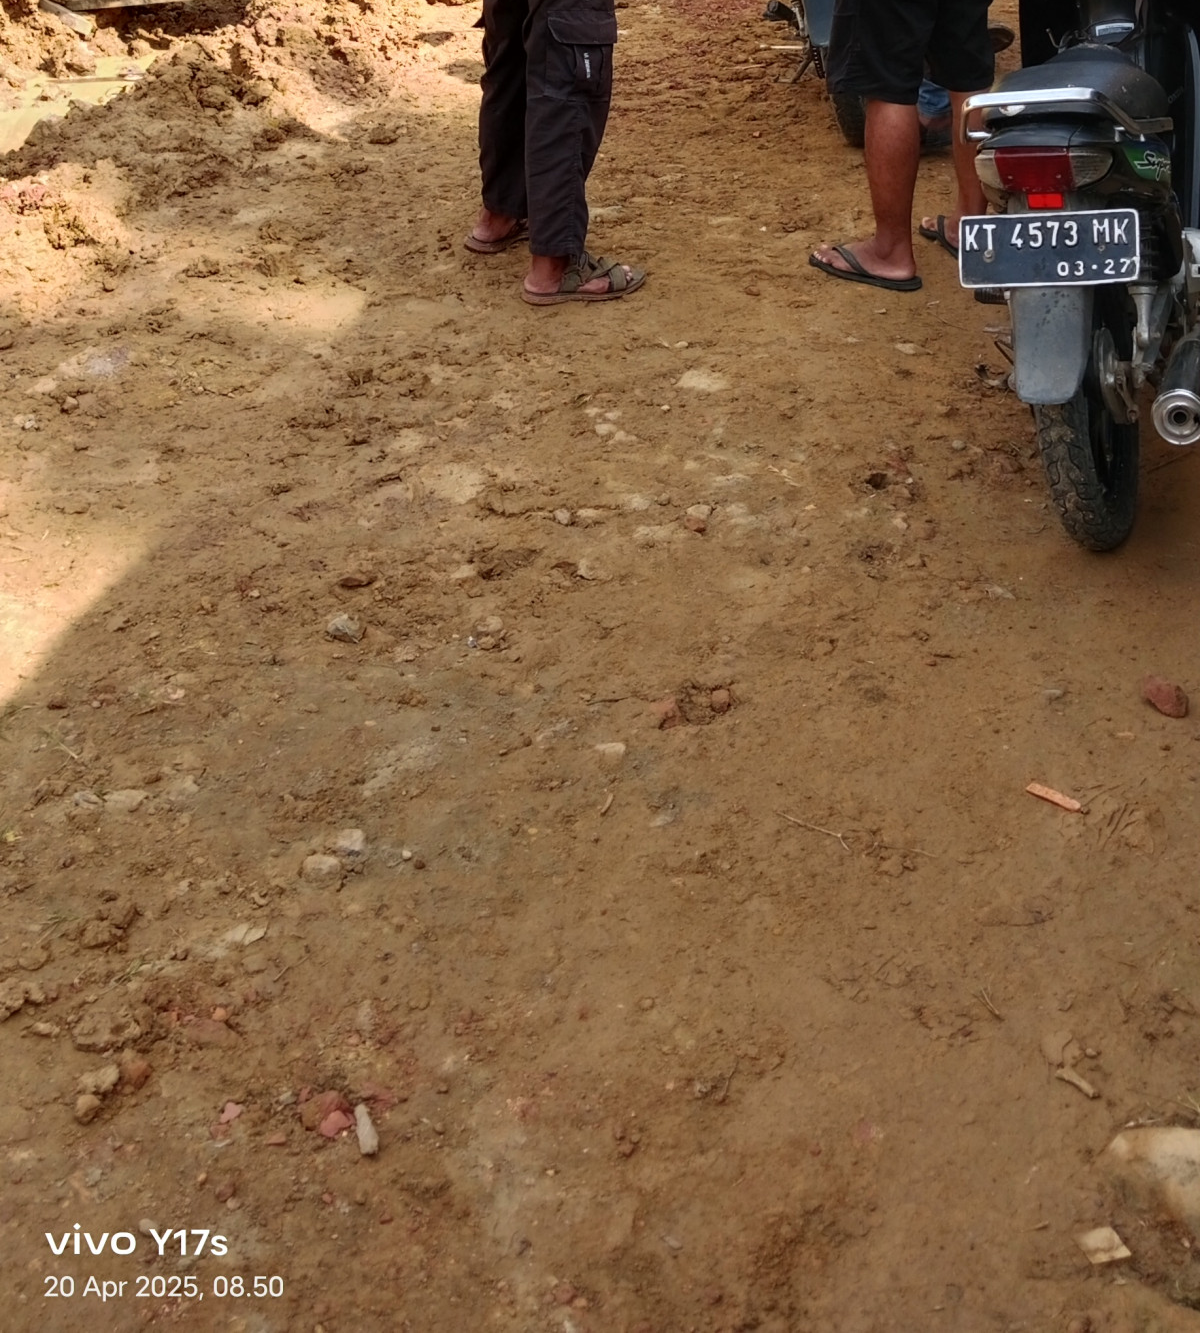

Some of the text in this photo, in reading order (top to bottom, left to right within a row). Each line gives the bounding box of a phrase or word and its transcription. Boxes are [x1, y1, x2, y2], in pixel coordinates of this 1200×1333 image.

[965, 218, 1130, 252] KT 4573 MK
